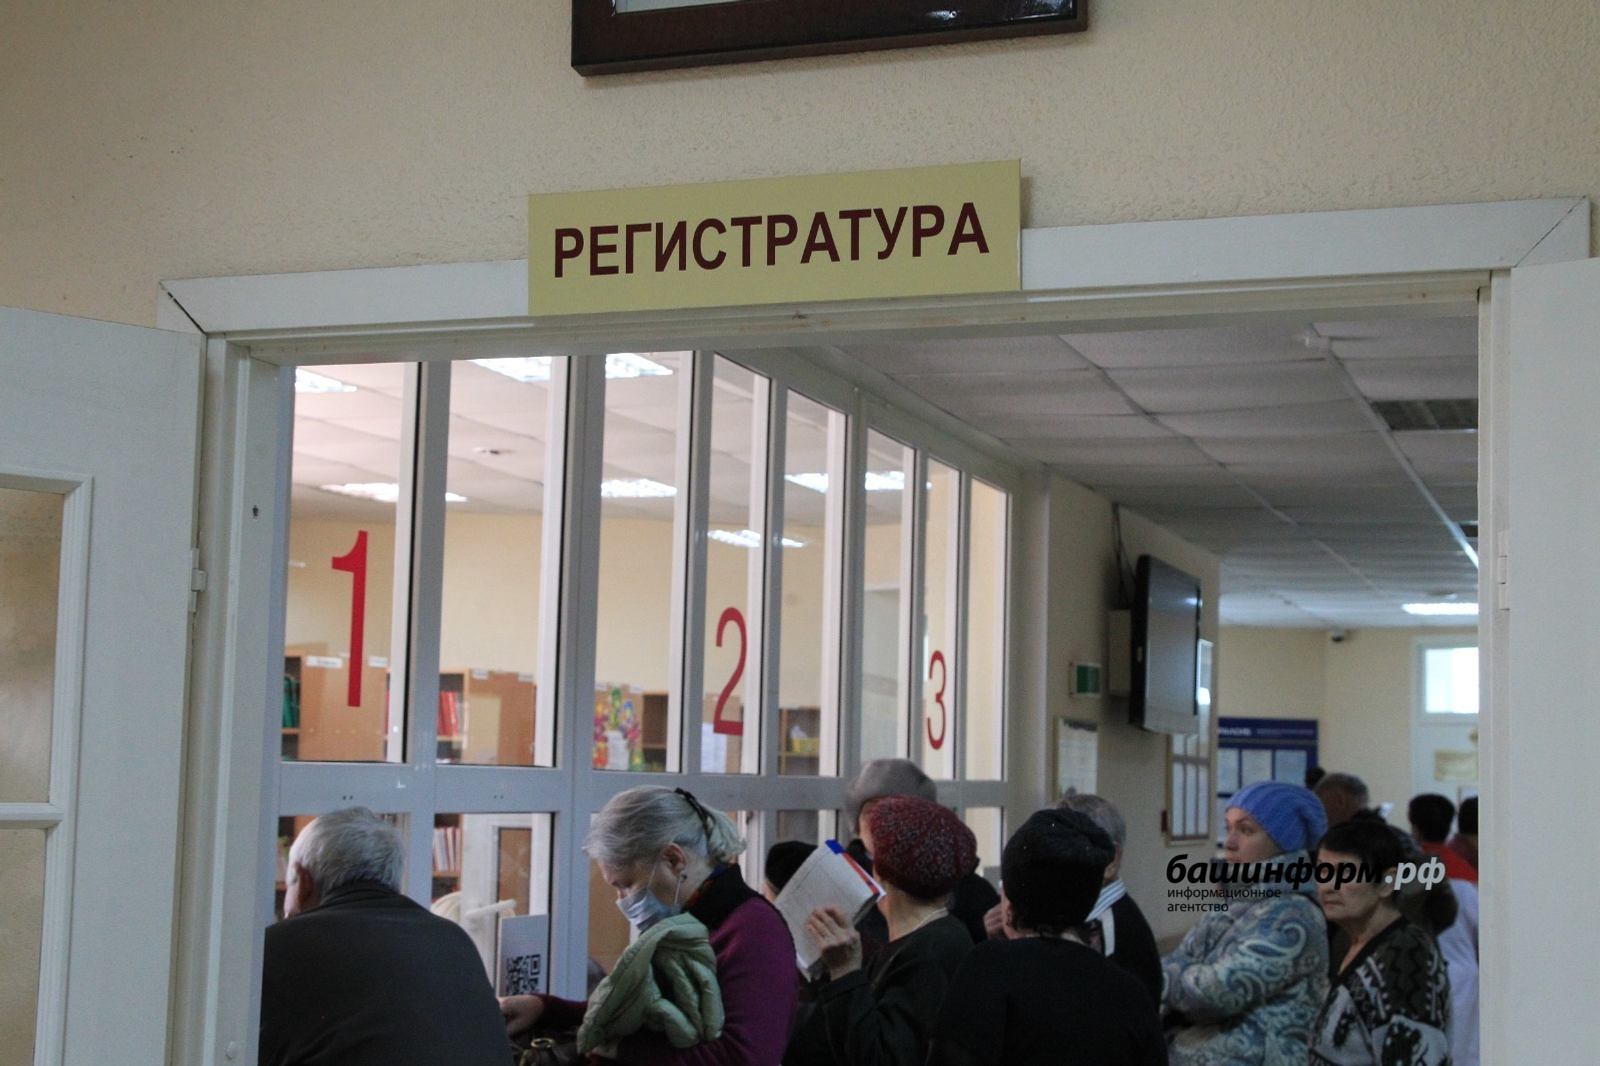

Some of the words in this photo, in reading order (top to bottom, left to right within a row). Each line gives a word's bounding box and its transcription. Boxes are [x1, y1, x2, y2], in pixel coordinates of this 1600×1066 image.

[554, 202, 990, 278] РЕГИСТРАТУРА
[331, 529, 369, 708] 1
[713, 607, 747, 736] 2
[927, 650, 947, 751] 3
